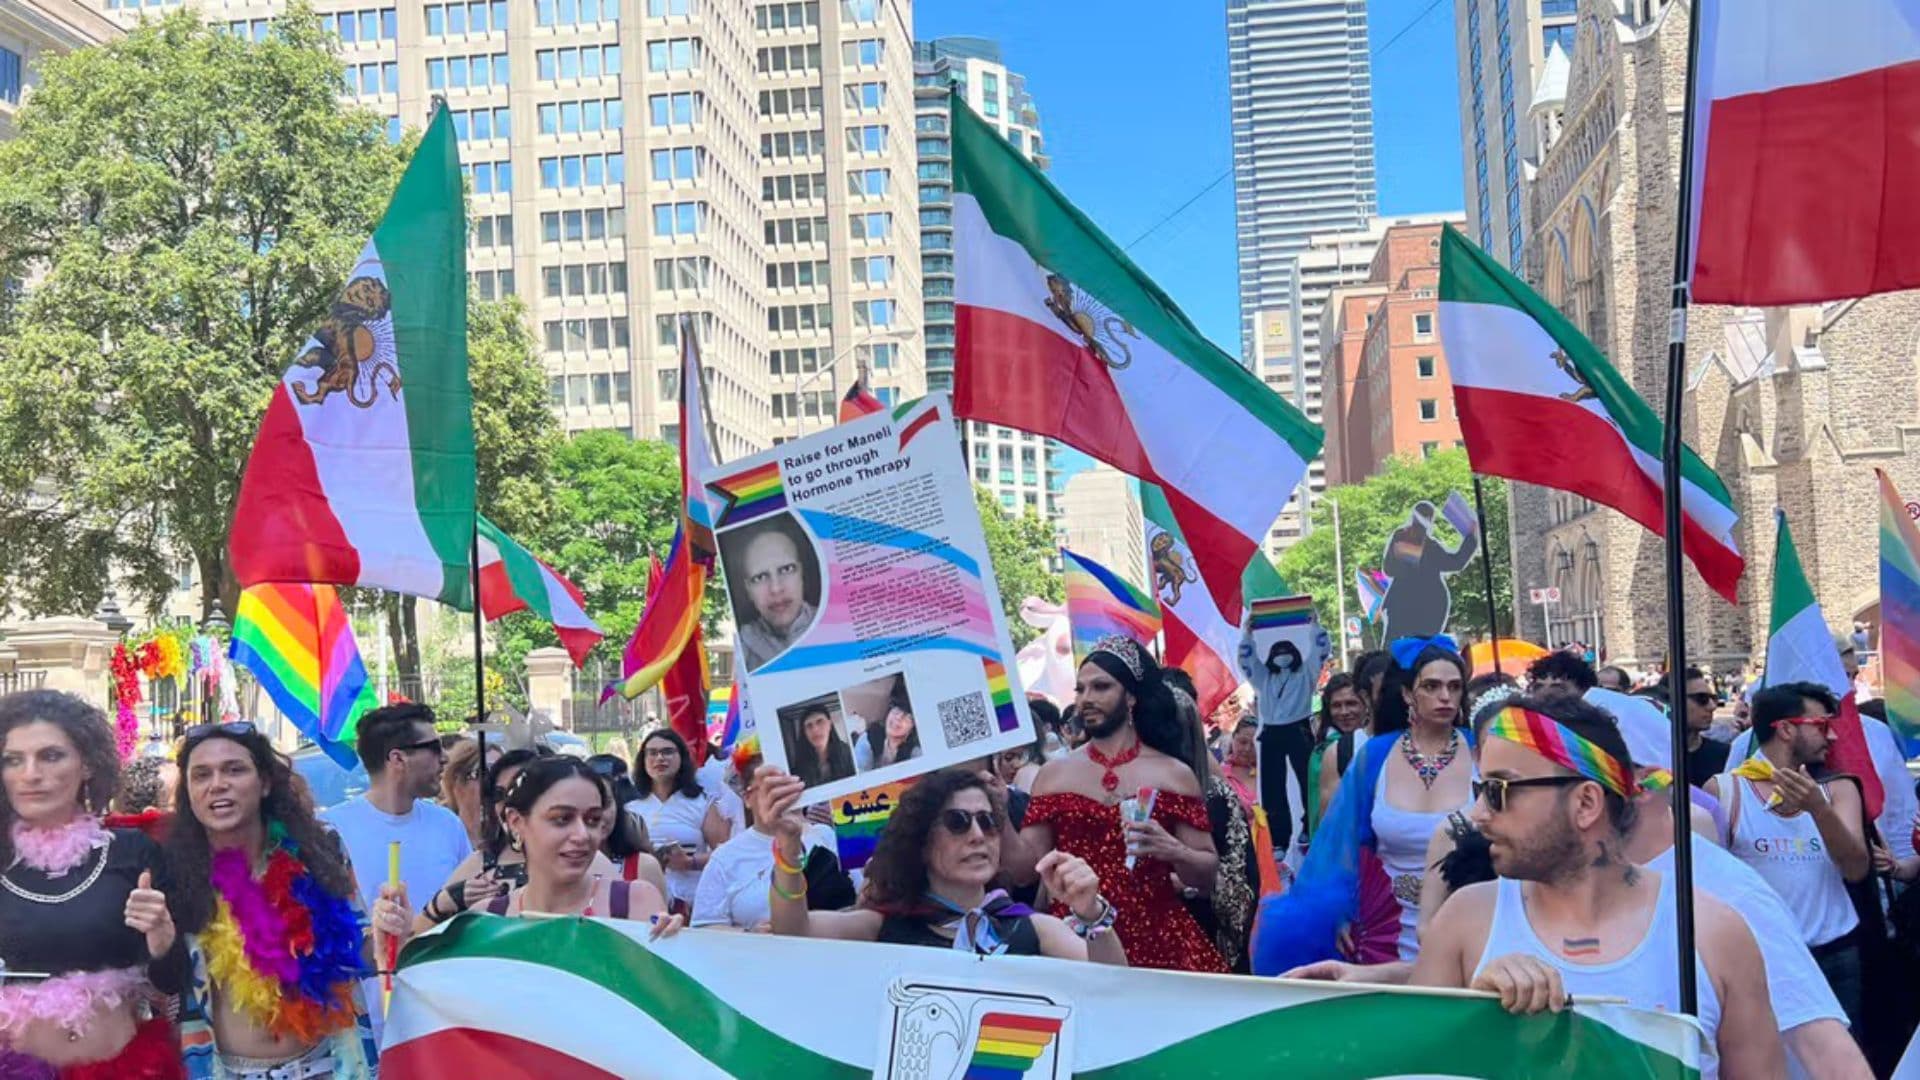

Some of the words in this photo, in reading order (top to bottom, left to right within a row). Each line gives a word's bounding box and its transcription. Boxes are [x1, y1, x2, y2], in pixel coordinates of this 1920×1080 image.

[784, 450, 822, 471] Raise
[824, 443, 844, 457] for
[847, 425, 892, 449] Maneli
[788, 475, 802, 487] to
[805, 468, 823, 483] go
[825, 448, 879, 474] through
[792, 476, 853, 502] Hormone
[856, 456, 911, 481] Therapy
